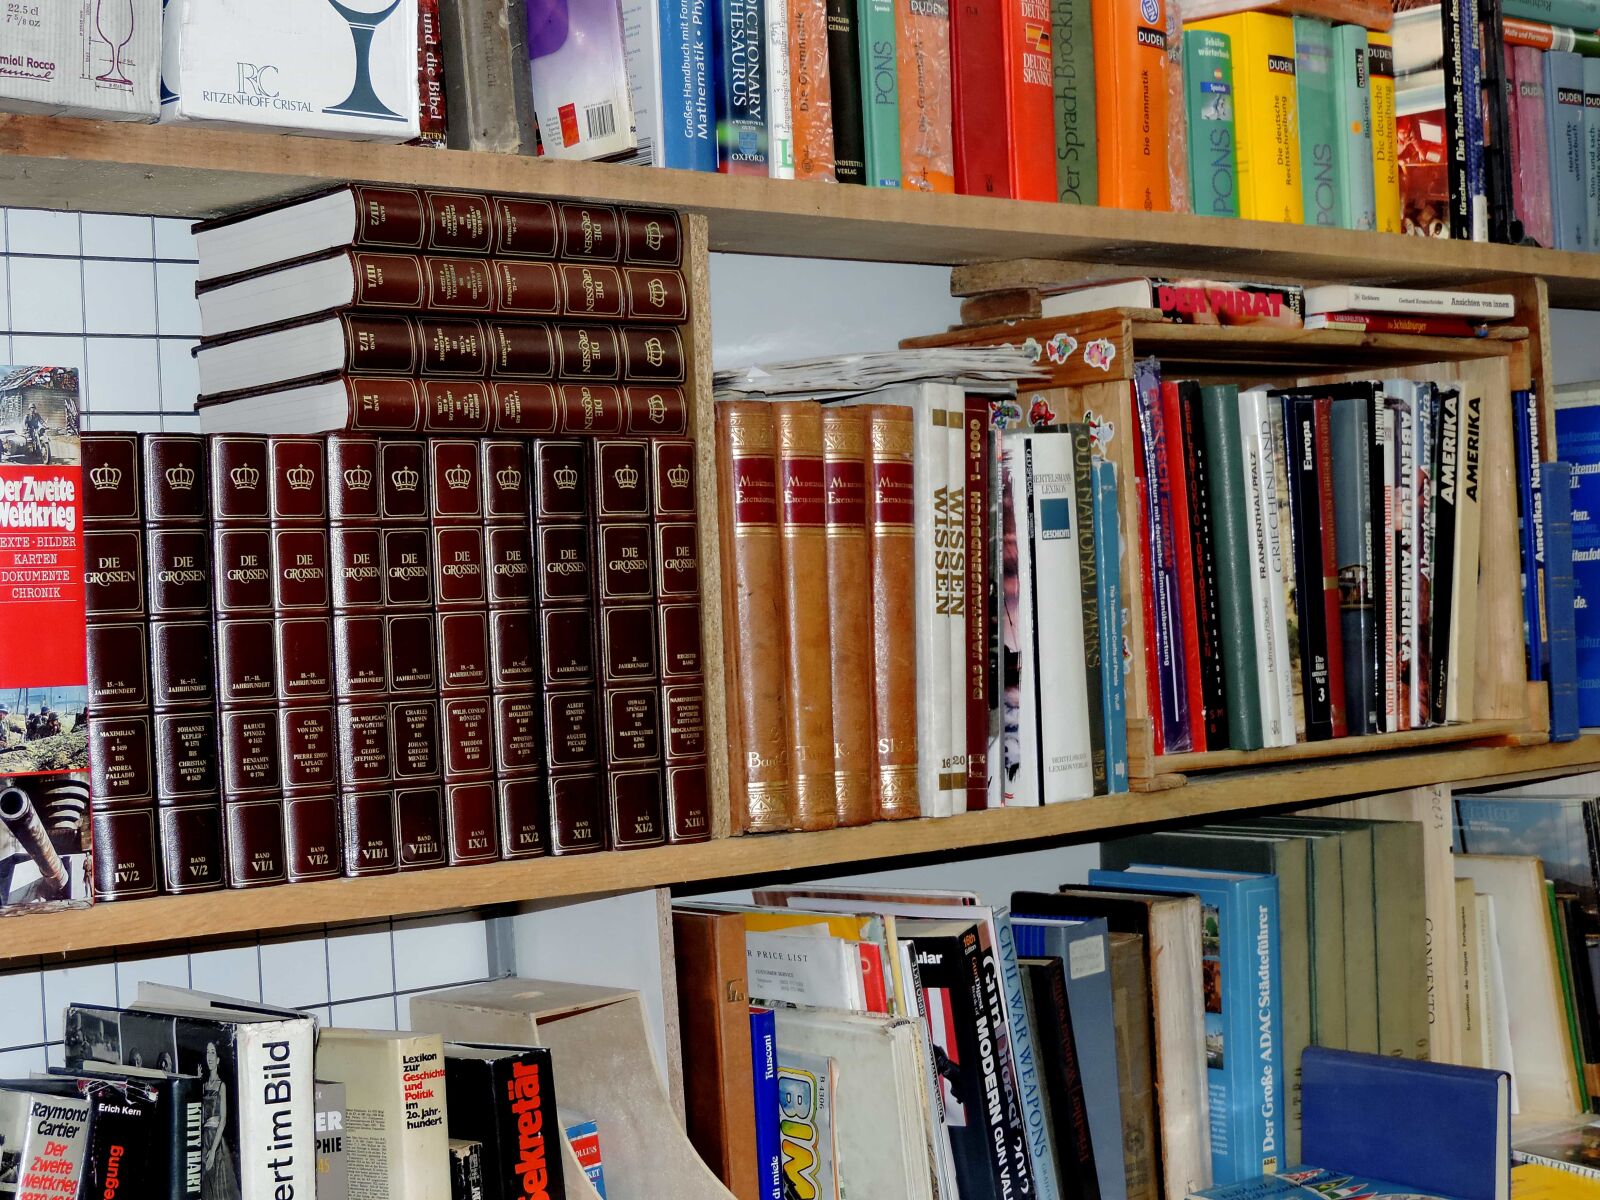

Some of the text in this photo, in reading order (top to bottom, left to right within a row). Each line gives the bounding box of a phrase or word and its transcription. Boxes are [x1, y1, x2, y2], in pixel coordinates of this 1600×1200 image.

[8, 3, 39, 16] 22.5 cl
[423, 13, 437, 45] und
[1138, 31, 1165, 46] DUDEN
[26, 57, 56, 71] Rocco
[426, 52, 438, 77] die
[1159, 56, 1165, 67] 4
[1269, 58, 1293, 73] DUDEN
[874, 41, 895, 105] PONS
[1357, 54, 1365, 88] DUDEN
[680, 23, 694, 138] Großes Handbuch mit
[693, 42, 707, 140] Mathematik
[1558, 92, 1582, 103] DUDEN
[203, 90, 314, 113] RITZENHOFF CRISTAL
[428, 82, 442, 120] Bibel
[1273, 95, 1283, 143] deutsche
[1374, 84, 1385, 161] Die deutsche
[1281, 96, 1292, 186] Rechtschreibung
[1385, 85, 1395, 184] Rechtschreibung
[731, 153, 764, 163] OXFORD
[1455, 144, 1466, 162] Die
[1209, 128, 1234, 214] PONS
[1061, 167, 1082, 205] Der
[1314, 143, 1336, 226] PONS
[1458, 169, 1467, 216] Kirschner
[370, 201, 379, 226] III/2
[582, 210, 592, 253] GROSSEN
[593, 223, 602, 241] DIE
[366, 264, 377, 288] III/1
[582, 268, 594, 312] GROSSEN
[594, 281, 605, 299] DIE
[1158, 286, 1284, 318] DER PIRAT
[1451, 298, 1481, 308] Ansichten
[359, 331, 369, 351] II/2
[578, 329, 591, 373] GROSSEN
[591, 341, 601, 360] DIE
[364, 395, 373, 410] I/1
[581, 387, 592, 429] GROSSEN
[594, 399, 604, 416] DIE
[1303, 420, 1313, 471] Europa
[1527, 393, 1541, 488] Naturwunder
[1075, 436, 1091, 480] OUR
[1441, 396, 1459, 505] AMERIKA
[1466, 397, 1480, 503] AMERIKA
[1142, 391, 1149, 405] CD
[1155, 524, 1163, 569] deutscher
[1419, 393, 1431, 580] Abenteuer Amerika
[22, 476, 75, 502] Zweite
[1261, 420, 1282, 573] GRIECHENLAND
[0, 502, 76, 531] Weltkrieg
[1250, 451, 1267, 579] FRANKENTHAL/PFALZ
[1533, 493, 1544, 562] Amerikas
[37, 536, 76, 548] BILDER
[1077, 488, 1096, 593] NATIONAL
[401, 553, 418, 564] DIE
[455, 551, 470, 562] DIE
[506, 550, 521, 561] DIE
[560, 549, 578, 560] DIE
[622, 547, 638, 558] DIE
[676, 546, 690, 557] DIE
[933, 484, 950, 617] WISSEN
[948, 486, 965, 618] WISSEN
[14, 554, 57, 565] KARTEN
[99, 557, 120, 569] DIE
[174, 557, 194, 568] DIE
[240, 556, 257, 566] DIE
[296, 555, 313, 566] DIE
[353, 554, 370, 565] DIE
[609, 559, 648, 573] GROSSEN
[1, 571, 70, 582] DOKUMENTE
[84, 571, 136, 587] GROSSEN
[159, 570, 206, 585] GROSSEN
[228, 569, 269, 584] GROSSEN
[284, 568, 324, 582] GROSSEN
[389, 566, 428, 581] GROSSEN
[443, 564, 480, 578] GROSSEN
[12, 588, 61, 598] CHRONIK
[1401, 550, 1413, 661] AMERIKA
[972, 664, 983, 700] DAS
[1318, 688, 1325, 702] 3
[953, 755, 965, 765] 20
[573, 829, 592, 840] XI/1
[635, 823, 653, 834] XI/2
[468, 838, 488, 849] IX/1
[520, 833, 539, 844] IX/2
[307, 855, 329, 865] VI/2
[362, 848, 389, 860] VII/1
[189, 866, 208, 876] V/2
[252, 861, 273, 871] VI/1
[114, 871, 140, 883] IV/2
[963, 933, 977, 946] 16th
[757, 951, 808, 962] PRICE LIST
[1258, 905, 1275, 1152] Der Große ADAC Städteführer
[999, 924, 1048, 1158] CIVIL WAR WEAPONS
[402, 1053, 437, 1064] Lexikon
[403, 1063, 420, 1073] zur
[404, 1081, 422, 1091] und
[818, 1076, 826, 1110] B 4306
[976, 1015, 1007, 1166] MODERN GUN
[262, 1040, 294, 1151] im Bild
[404, 1089, 434, 1101] Politik
[30, 1101, 89, 1123] Raymond
[99, 1103, 142, 1117] Erich Kern
[405, 1101, 418, 1110] im
[420, 1107, 441, 1121] Jahr-
[406, 1116, 443, 1130] hundert
[764, 1034, 781, 1200] di miele Rusconi
[37, 1120, 80, 1139] Cartier
[44, 1141, 68, 1157] Der
[30, 1155, 74, 1176] Zweite
[1264, 1157, 1276, 1166] ADAC
[22, 1173, 79, 1194] Weltkrieg
